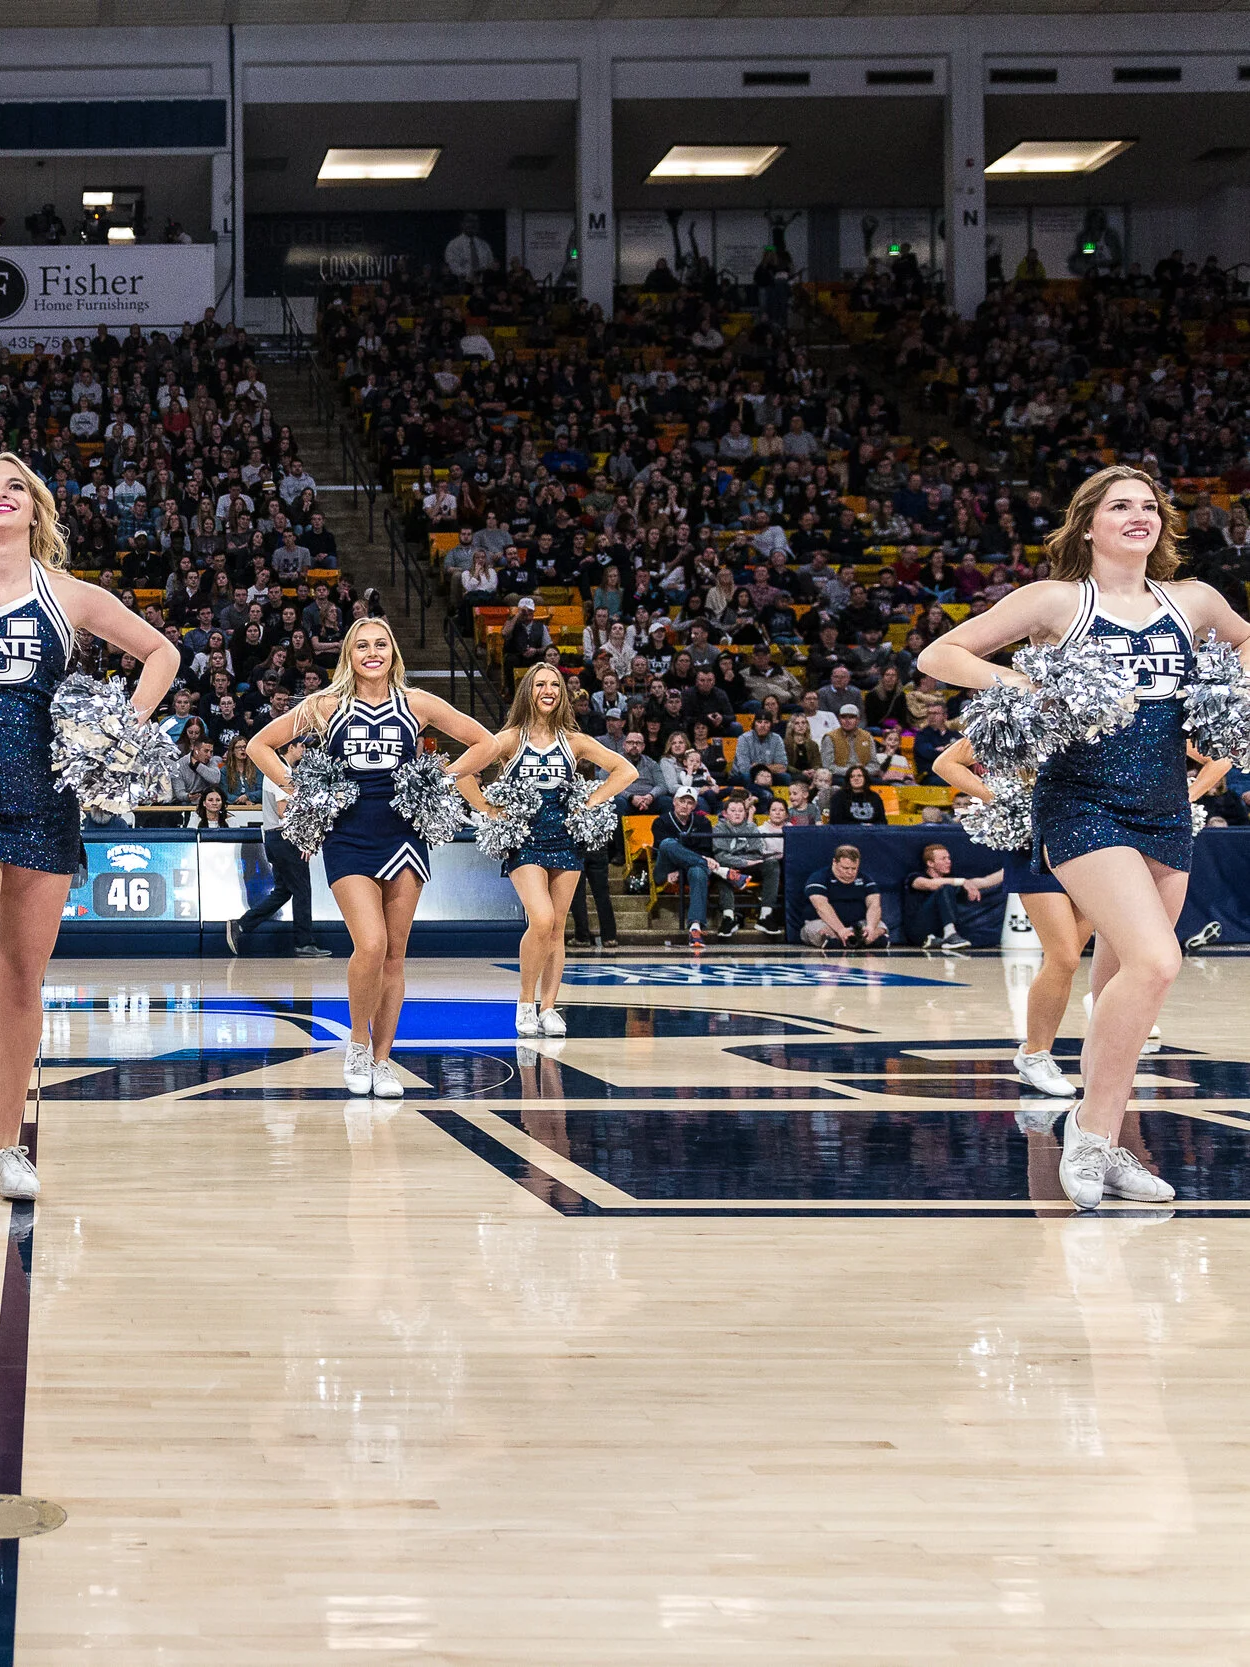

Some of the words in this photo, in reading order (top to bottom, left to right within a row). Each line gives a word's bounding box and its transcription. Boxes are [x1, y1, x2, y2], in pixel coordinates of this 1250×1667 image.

[588, 212, 606, 229] M
[963, 209, 978, 226] N
[38, 263, 144, 296] Fisher
[33, 298, 73, 311] Home
[76, 297, 150, 314] Furnishings
[1115, 654, 1186, 677] TATE
[343, 738, 404, 756] STATE
[518, 765, 567, 778] STATE
[107, 877, 150, 912] 46
